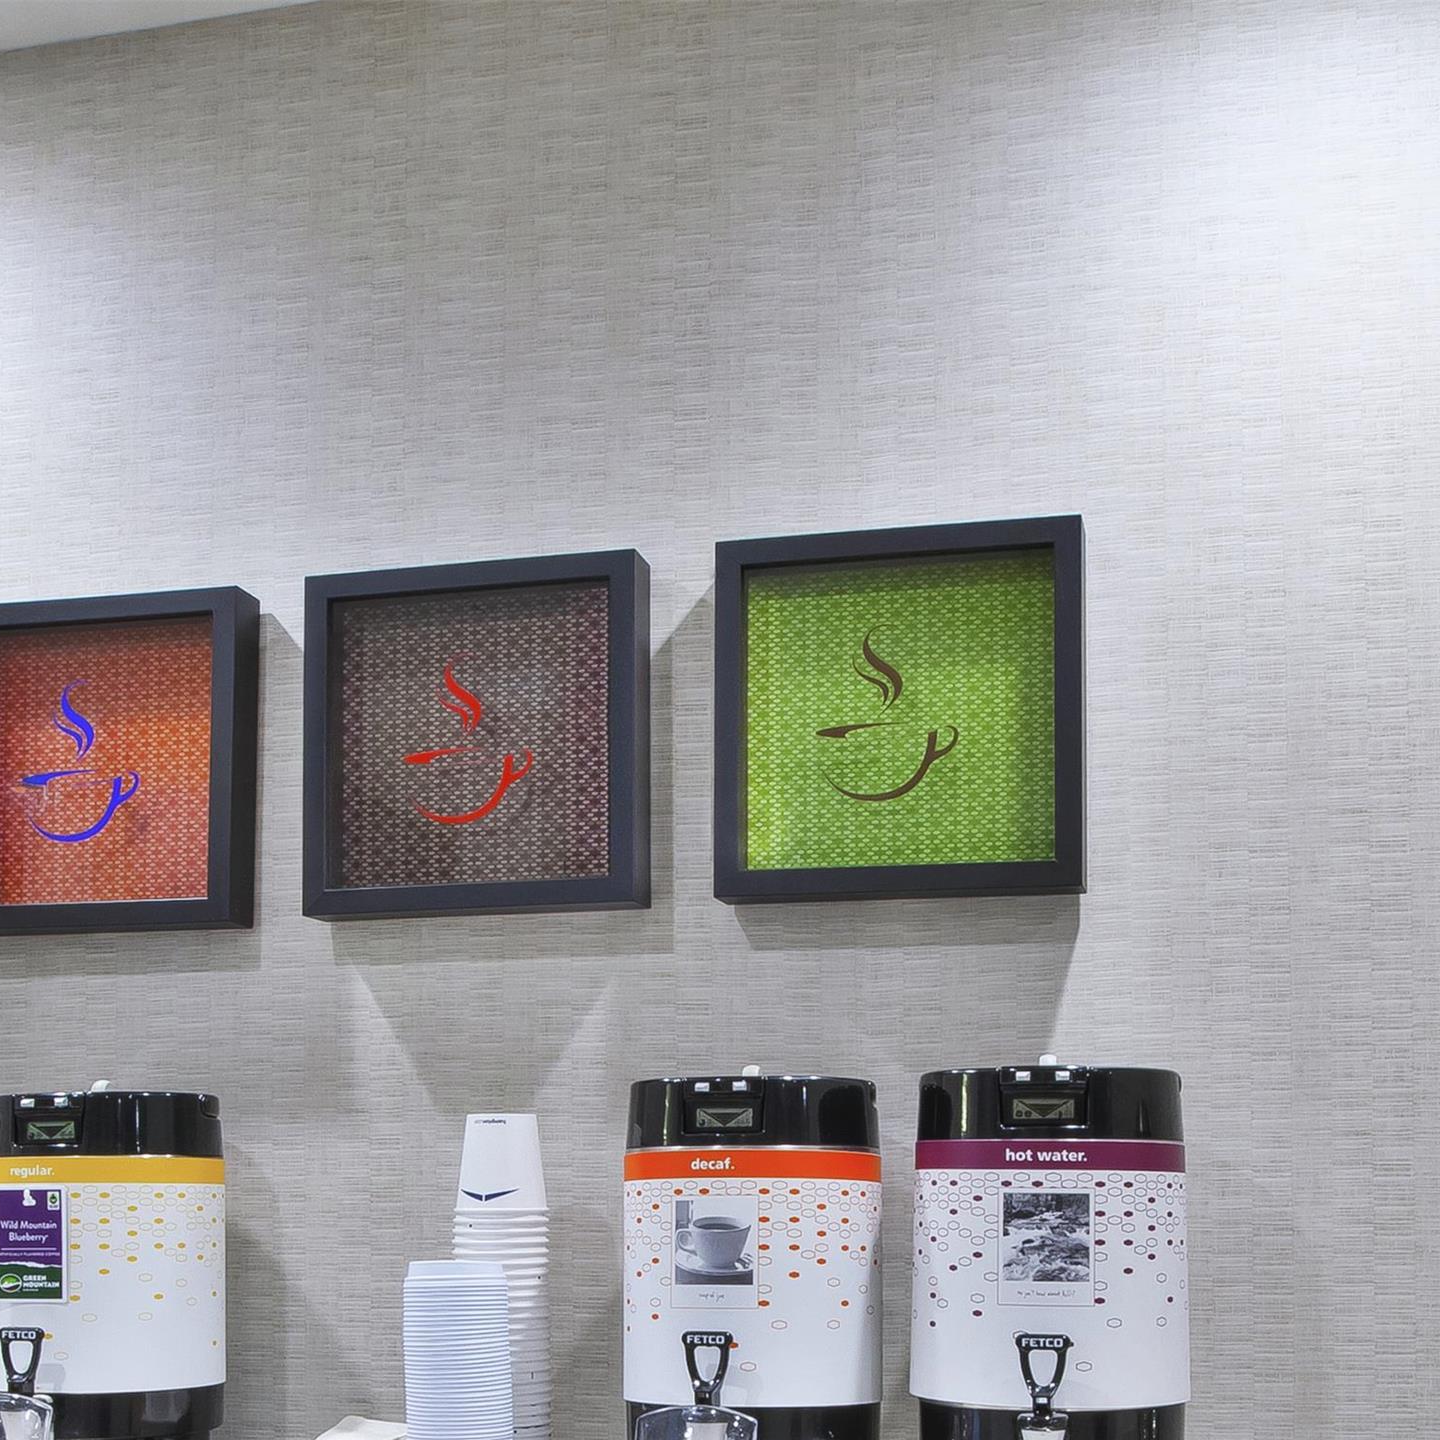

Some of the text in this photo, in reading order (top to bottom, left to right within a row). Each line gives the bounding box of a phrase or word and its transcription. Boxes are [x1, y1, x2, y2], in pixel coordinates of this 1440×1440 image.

[1005, 1147, 1088, 1162] hot water.
[691, 1157, 735, 1170] decaf.
[10, 1164, 55, 1178] regular.
[0, 1220, 58, 1230] Wild Mountain
[8, 1231, 49, 1244] Blueberry
[1, 1330, 37, 1340] FETCO
[686, 1335, 726, 1345] FETCO
[1021, 1338, 1064, 1348] FETCO
